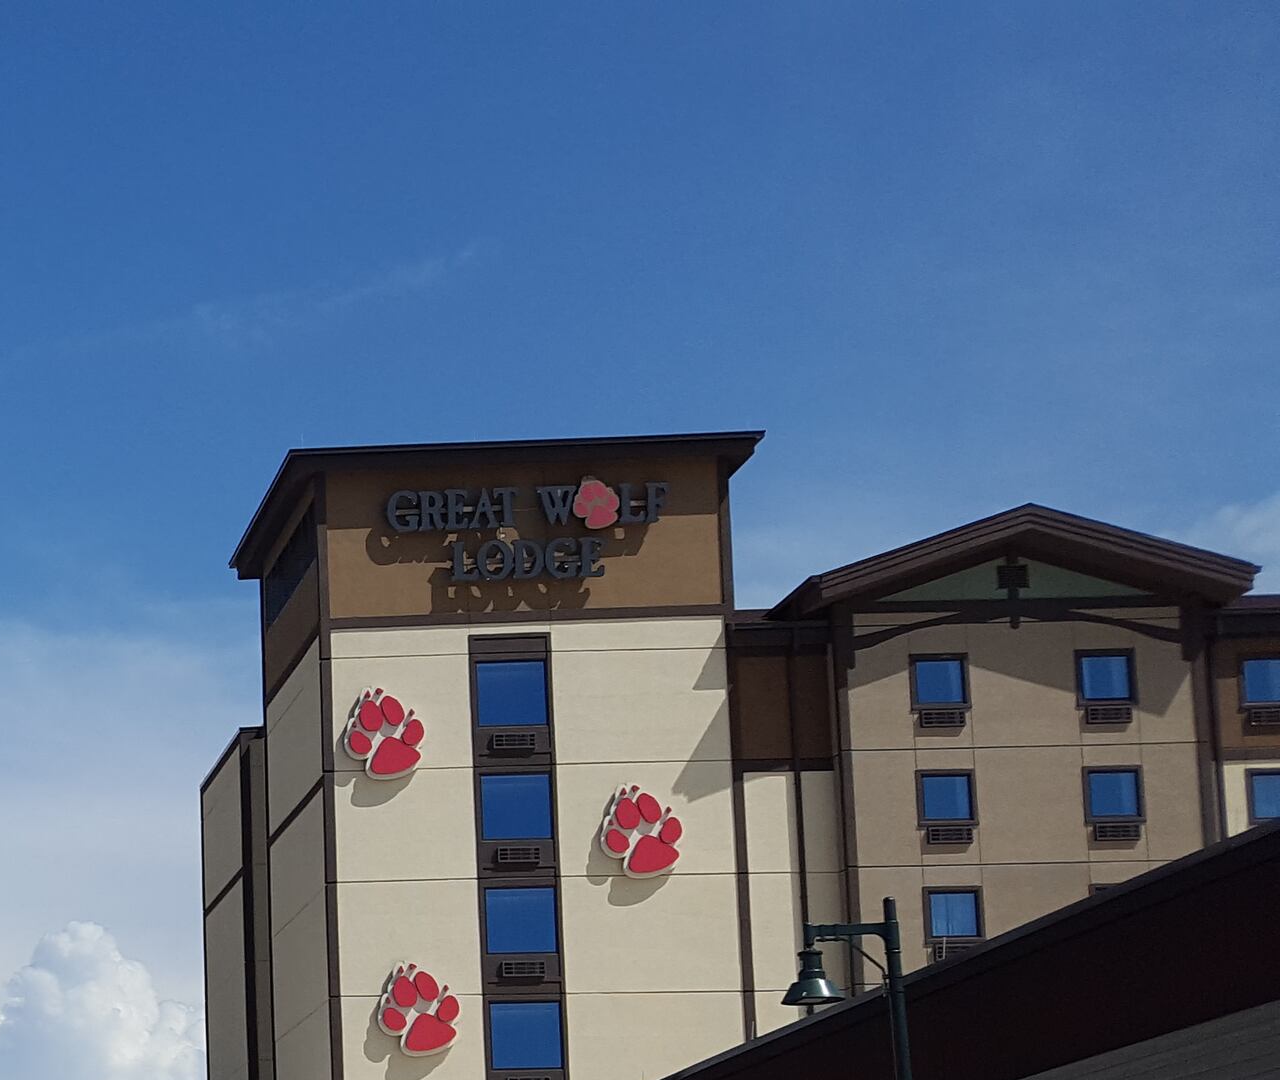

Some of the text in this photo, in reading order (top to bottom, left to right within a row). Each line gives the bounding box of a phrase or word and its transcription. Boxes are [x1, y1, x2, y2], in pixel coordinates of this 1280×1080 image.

[388, 476, 670, 532] GREAT WLF
[452, 537, 605, 581] LODGE
